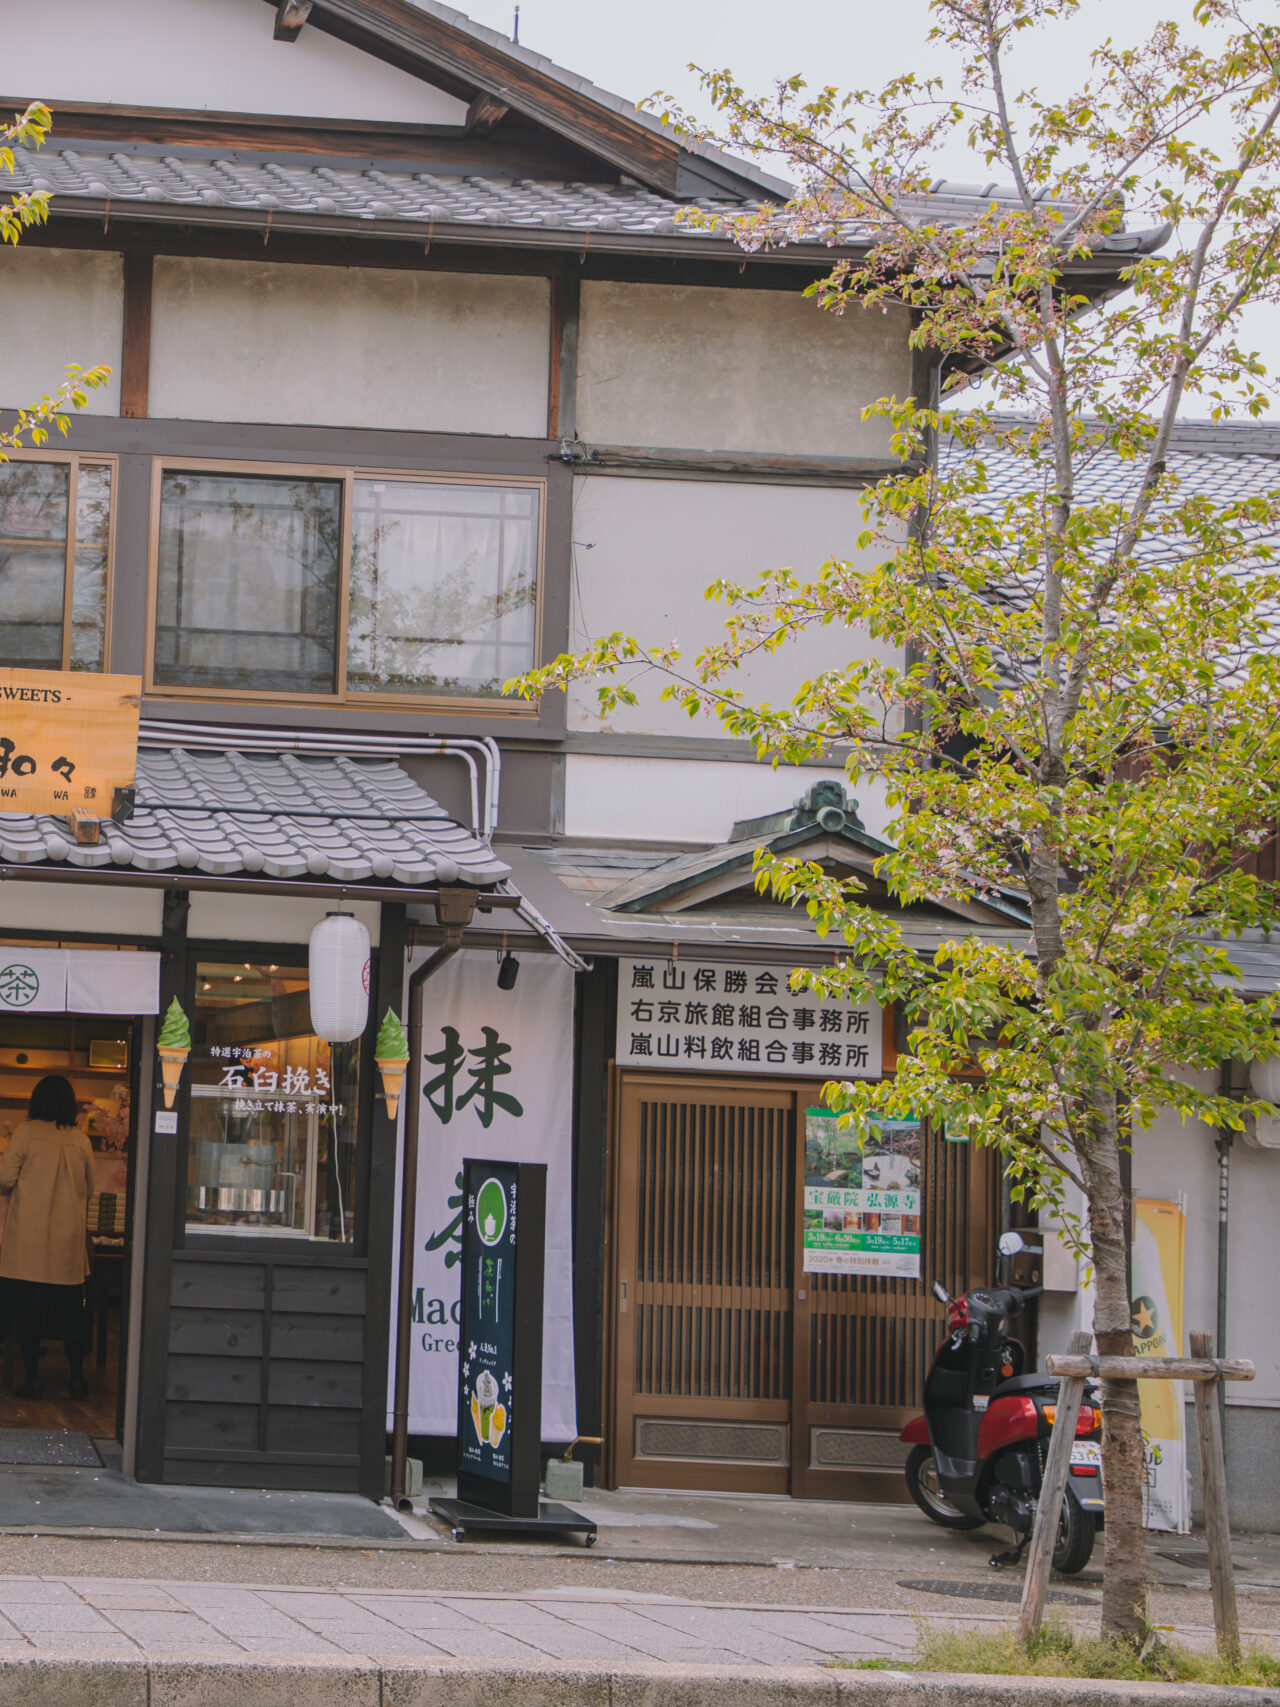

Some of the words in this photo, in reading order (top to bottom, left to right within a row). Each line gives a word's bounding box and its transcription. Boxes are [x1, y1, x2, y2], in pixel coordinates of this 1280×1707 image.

[0, 788, 17, 798] WA
[53, 790, 69, 801] WA
[631, 964, 853, 999] 嵐山保勝会
[630, 999, 870, 1035] 右京旅館組合事務所
[210, 1046, 271, 1059] 特選宇治茶の
[629, 1032, 868, 1068] 嵐山料飲組合事務所
[218, 1065, 331, 1096] 石臼挽き
[867, 1192, 916, 1210] 弘源寺
